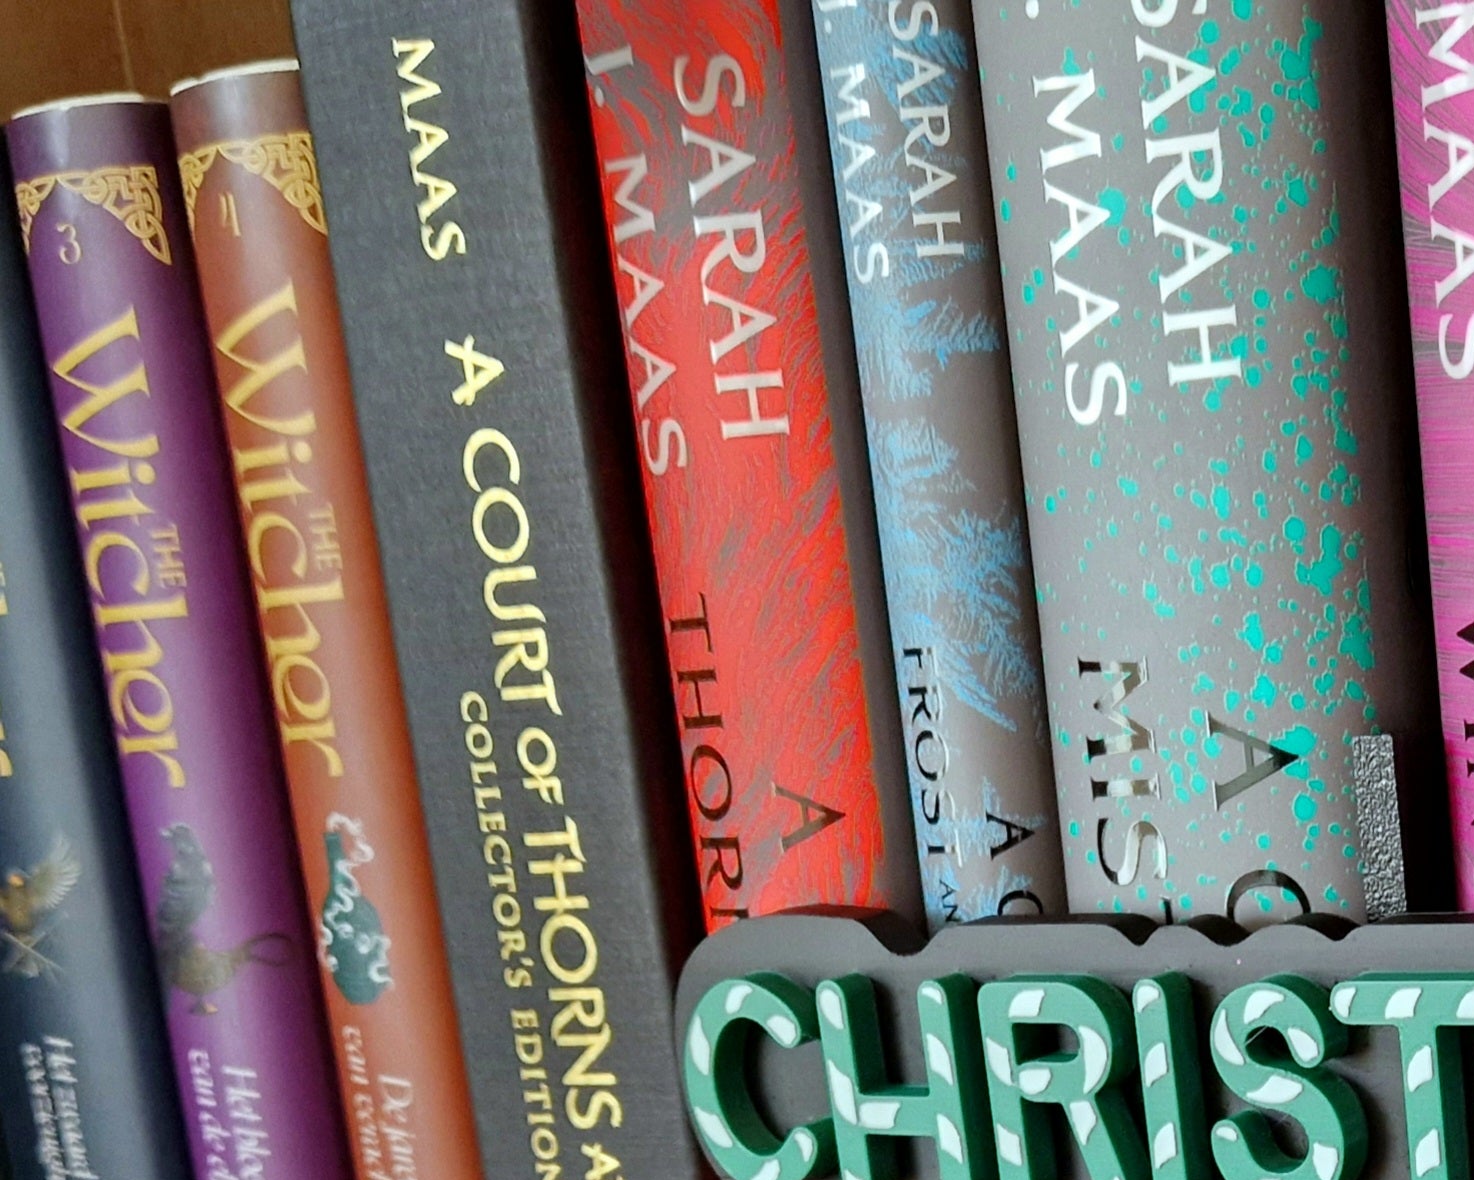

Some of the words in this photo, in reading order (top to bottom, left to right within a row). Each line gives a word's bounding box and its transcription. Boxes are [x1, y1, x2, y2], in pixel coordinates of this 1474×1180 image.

[392, 37, 467, 262] MAAS
[830, 63, 890, 285] MAAS
[887, 0, 965, 258] SARAH
[56, 222, 84, 266] 3
[604, 153, 688, 477] MAAS
[673, 55, 790, 440] SARAH
[1033, 67, 1127, 426] MAAS
[444, 333, 505, 407] A
[52, 304, 189, 789] Witcher
[150, 522, 188, 589] THE
[214, 279, 345, 778] Witcher
[306, 502, 343, 572] THE
[462, 427, 563, 716] COURT
[459, 690, 533, 990] COLLECTOR'S
[516, 727, 564, 805] OF
[772, 780, 847, 854] A
[902, 646, 963, 868] FROST
[985, 811, 1036, 860] A
[1077, 655, 1173, 925] MIS
[1205, 710, 1299, 812] A
[522, 815, 623, 1128] THORNS
